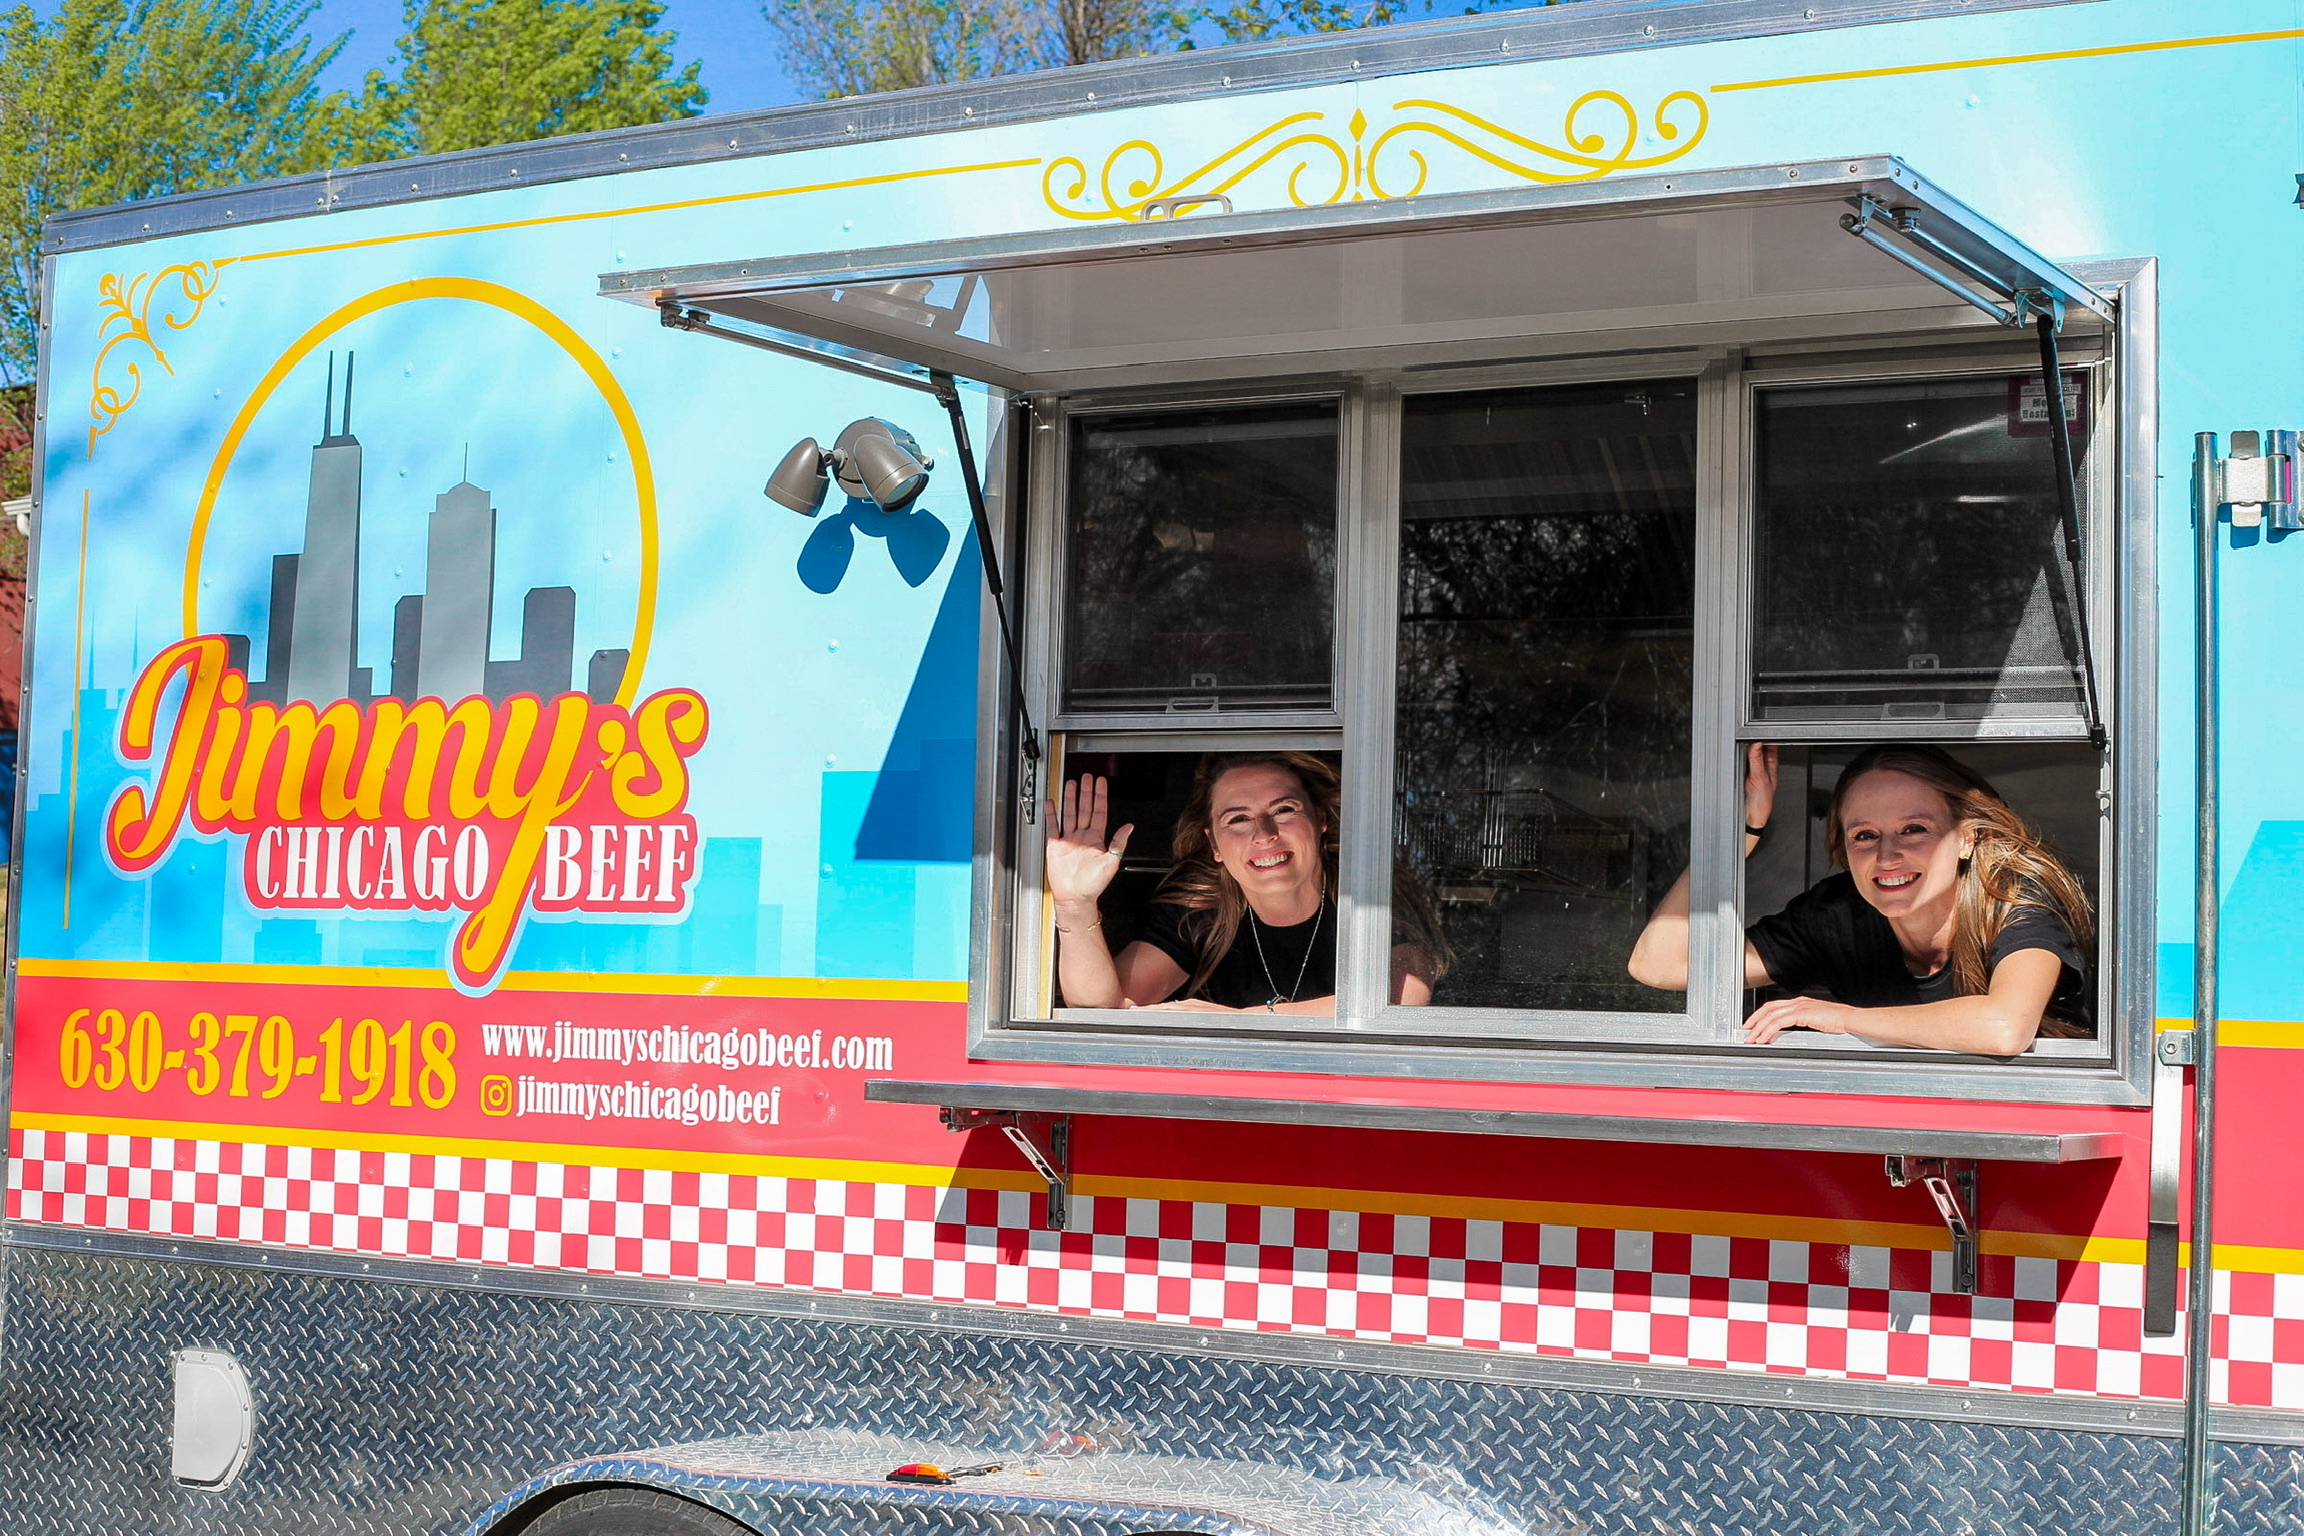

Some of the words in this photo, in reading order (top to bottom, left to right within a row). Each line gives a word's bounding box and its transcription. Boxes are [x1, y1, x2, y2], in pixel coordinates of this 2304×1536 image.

[113, 637, 707, 974] Jimmy's
[256, 824, 490, 901] CHICAGO
[540, 824, 690, 903] BEEF
[60, 1009, 457, 1110] 630-379-1918
[481, 1020, 893, 1071] www.jimmyschicagobeef.com
[516, 1075, 782, 1126] jimmyschicagobeef
